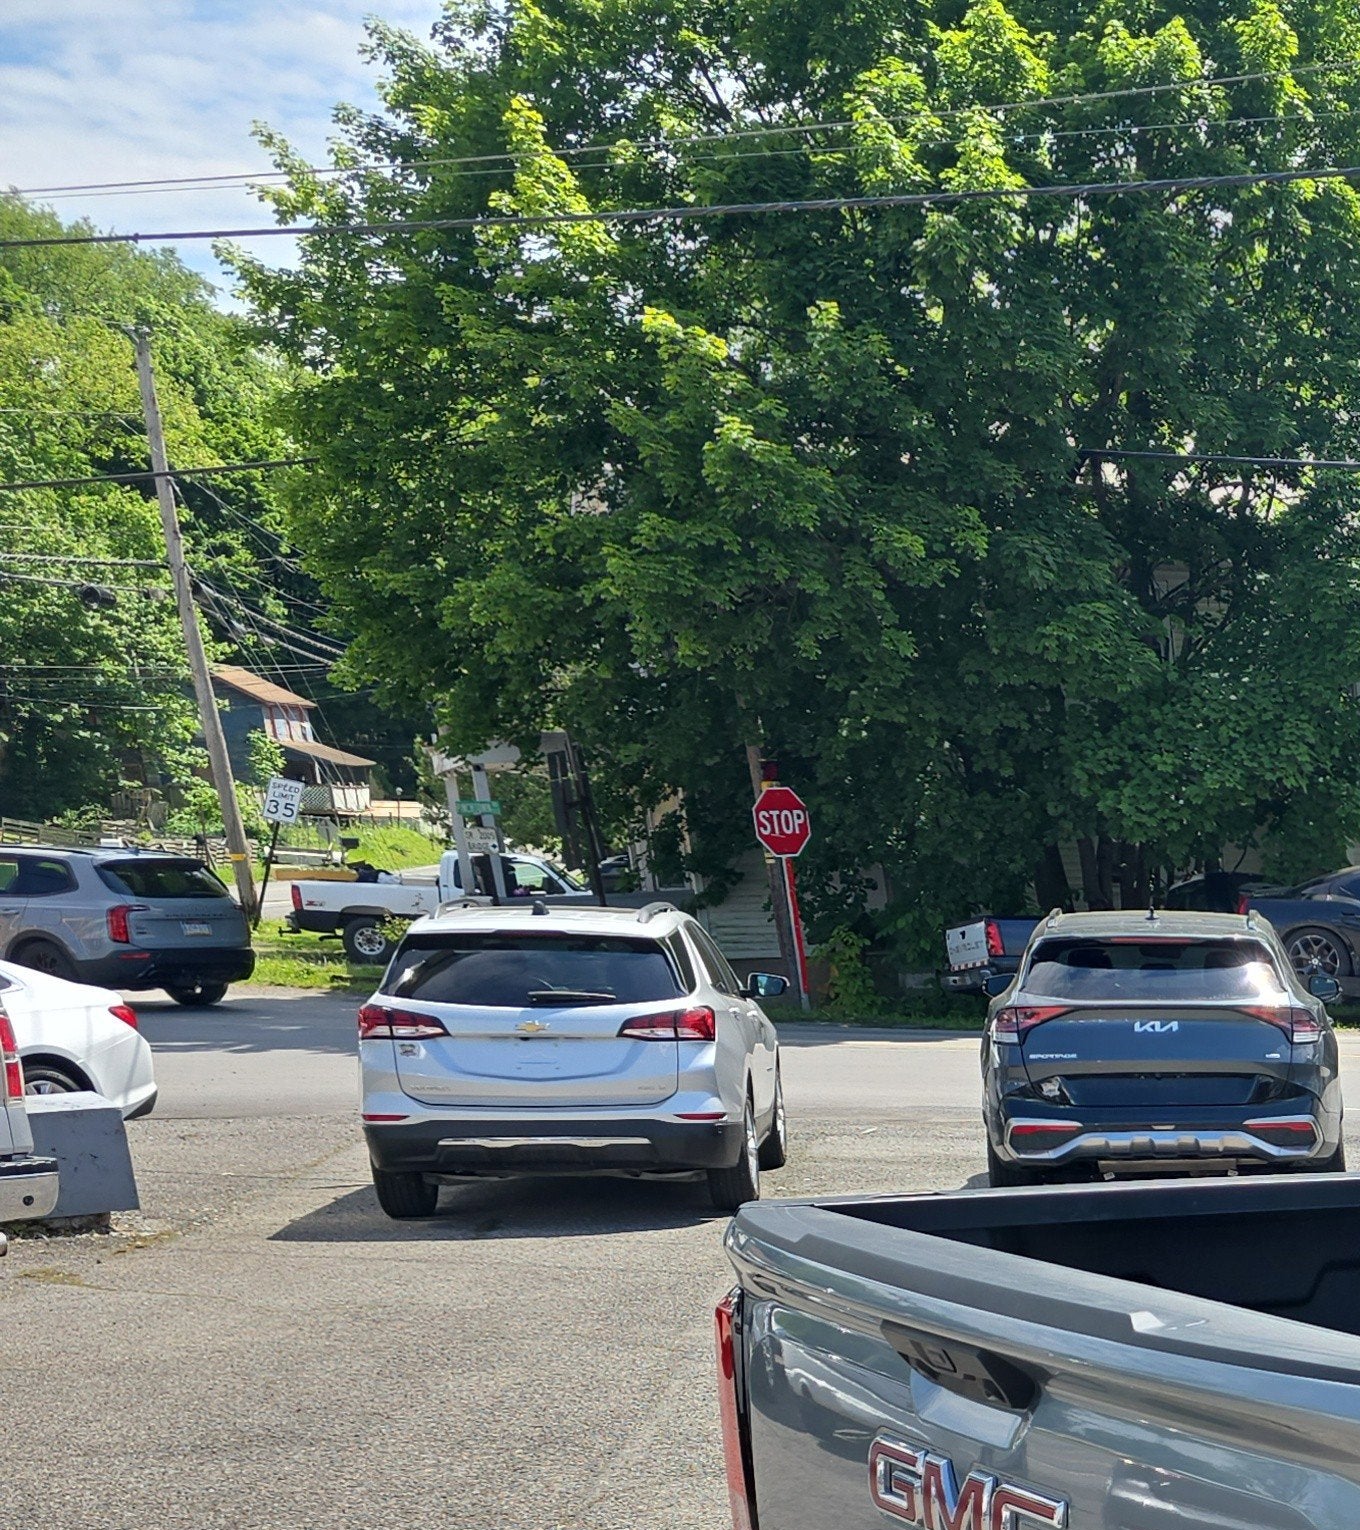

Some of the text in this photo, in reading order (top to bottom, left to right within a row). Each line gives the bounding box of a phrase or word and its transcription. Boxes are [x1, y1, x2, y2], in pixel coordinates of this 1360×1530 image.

[271, 782, 300, 794] SPEED
[266, 799, 296, 818] 35
[758, 809, 805, 835] STOP
[1133, 1020, 1179, 1033] KIA
